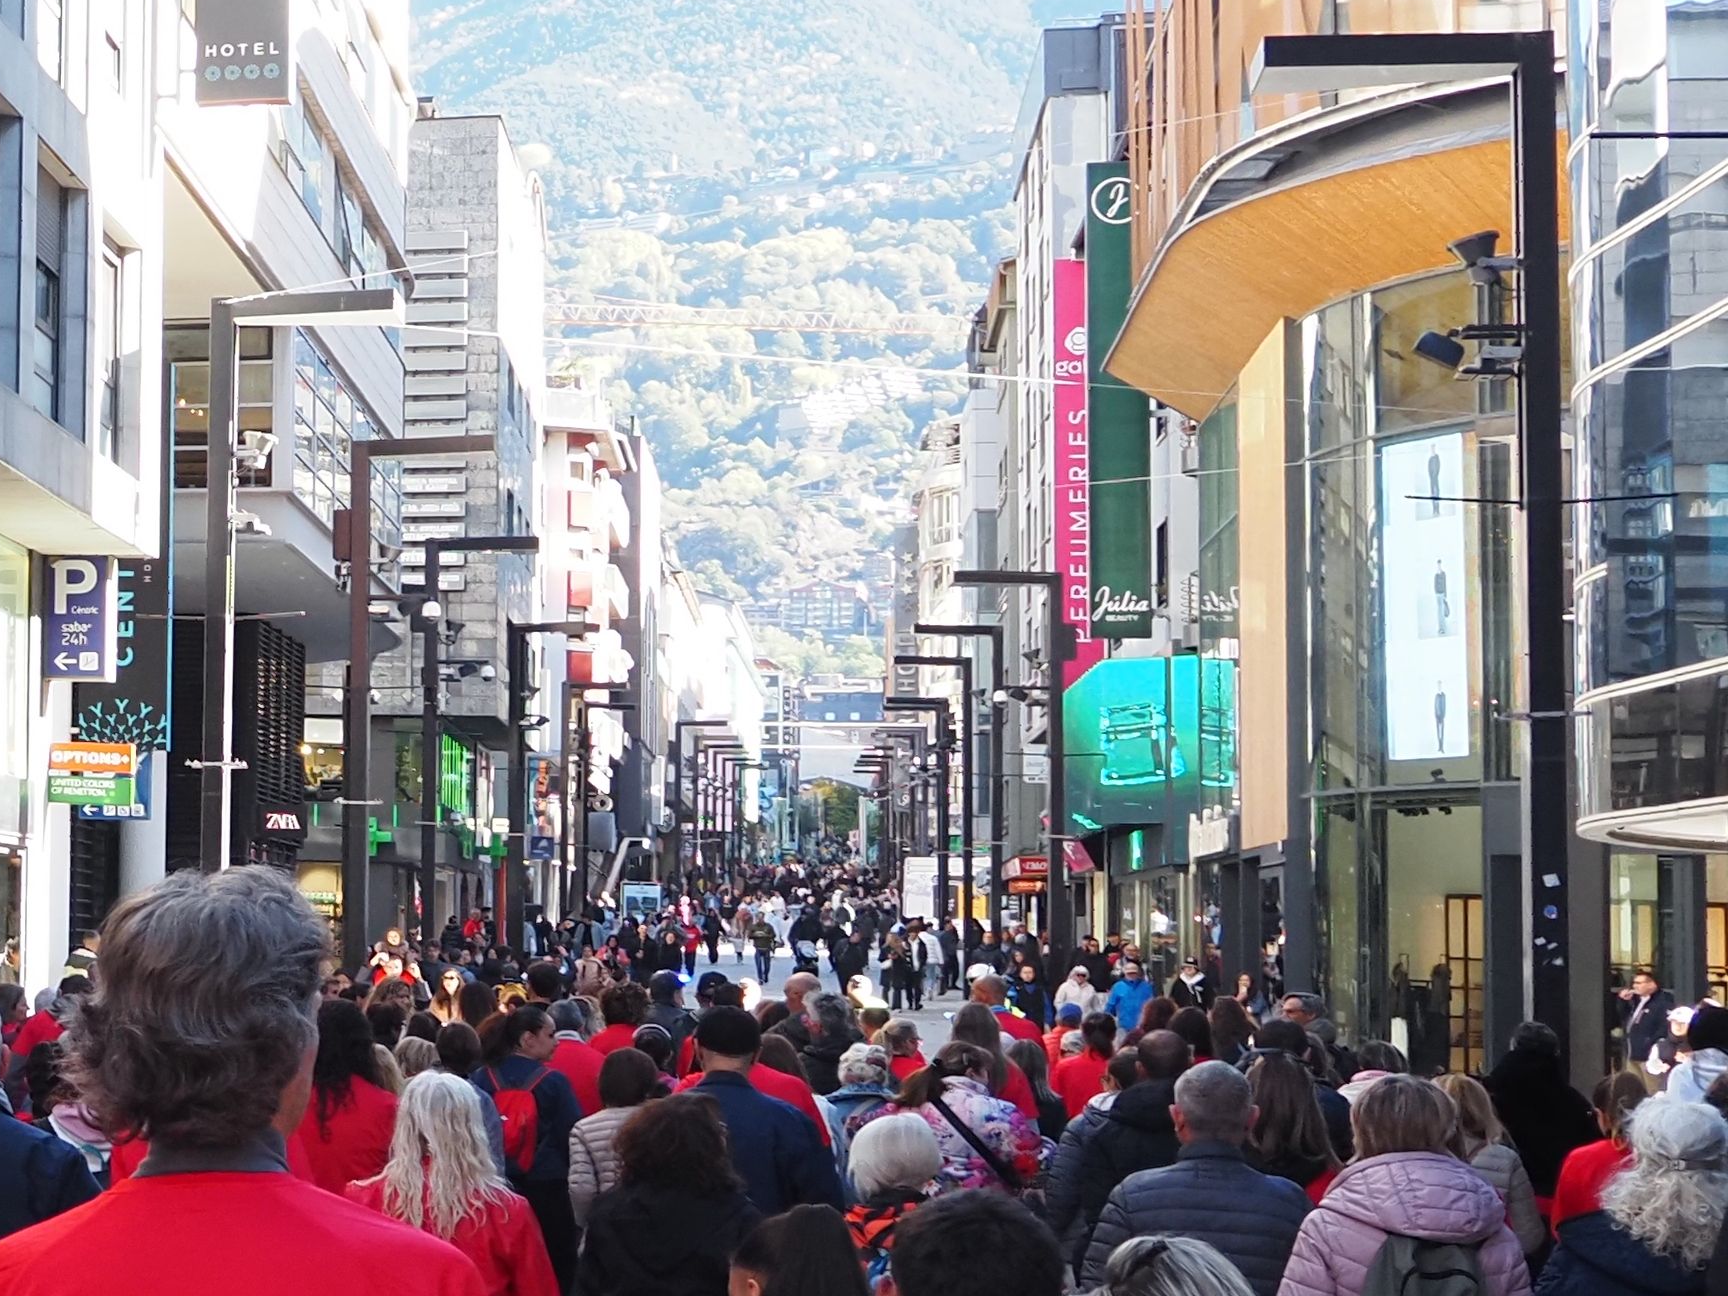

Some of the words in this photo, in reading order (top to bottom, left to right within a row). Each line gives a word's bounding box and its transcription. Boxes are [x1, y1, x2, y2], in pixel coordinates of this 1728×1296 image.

[205, 42, 280, 57] HOTEL
[50, 559, 98, 615] P
[61, 633, 87, 646] 24h
